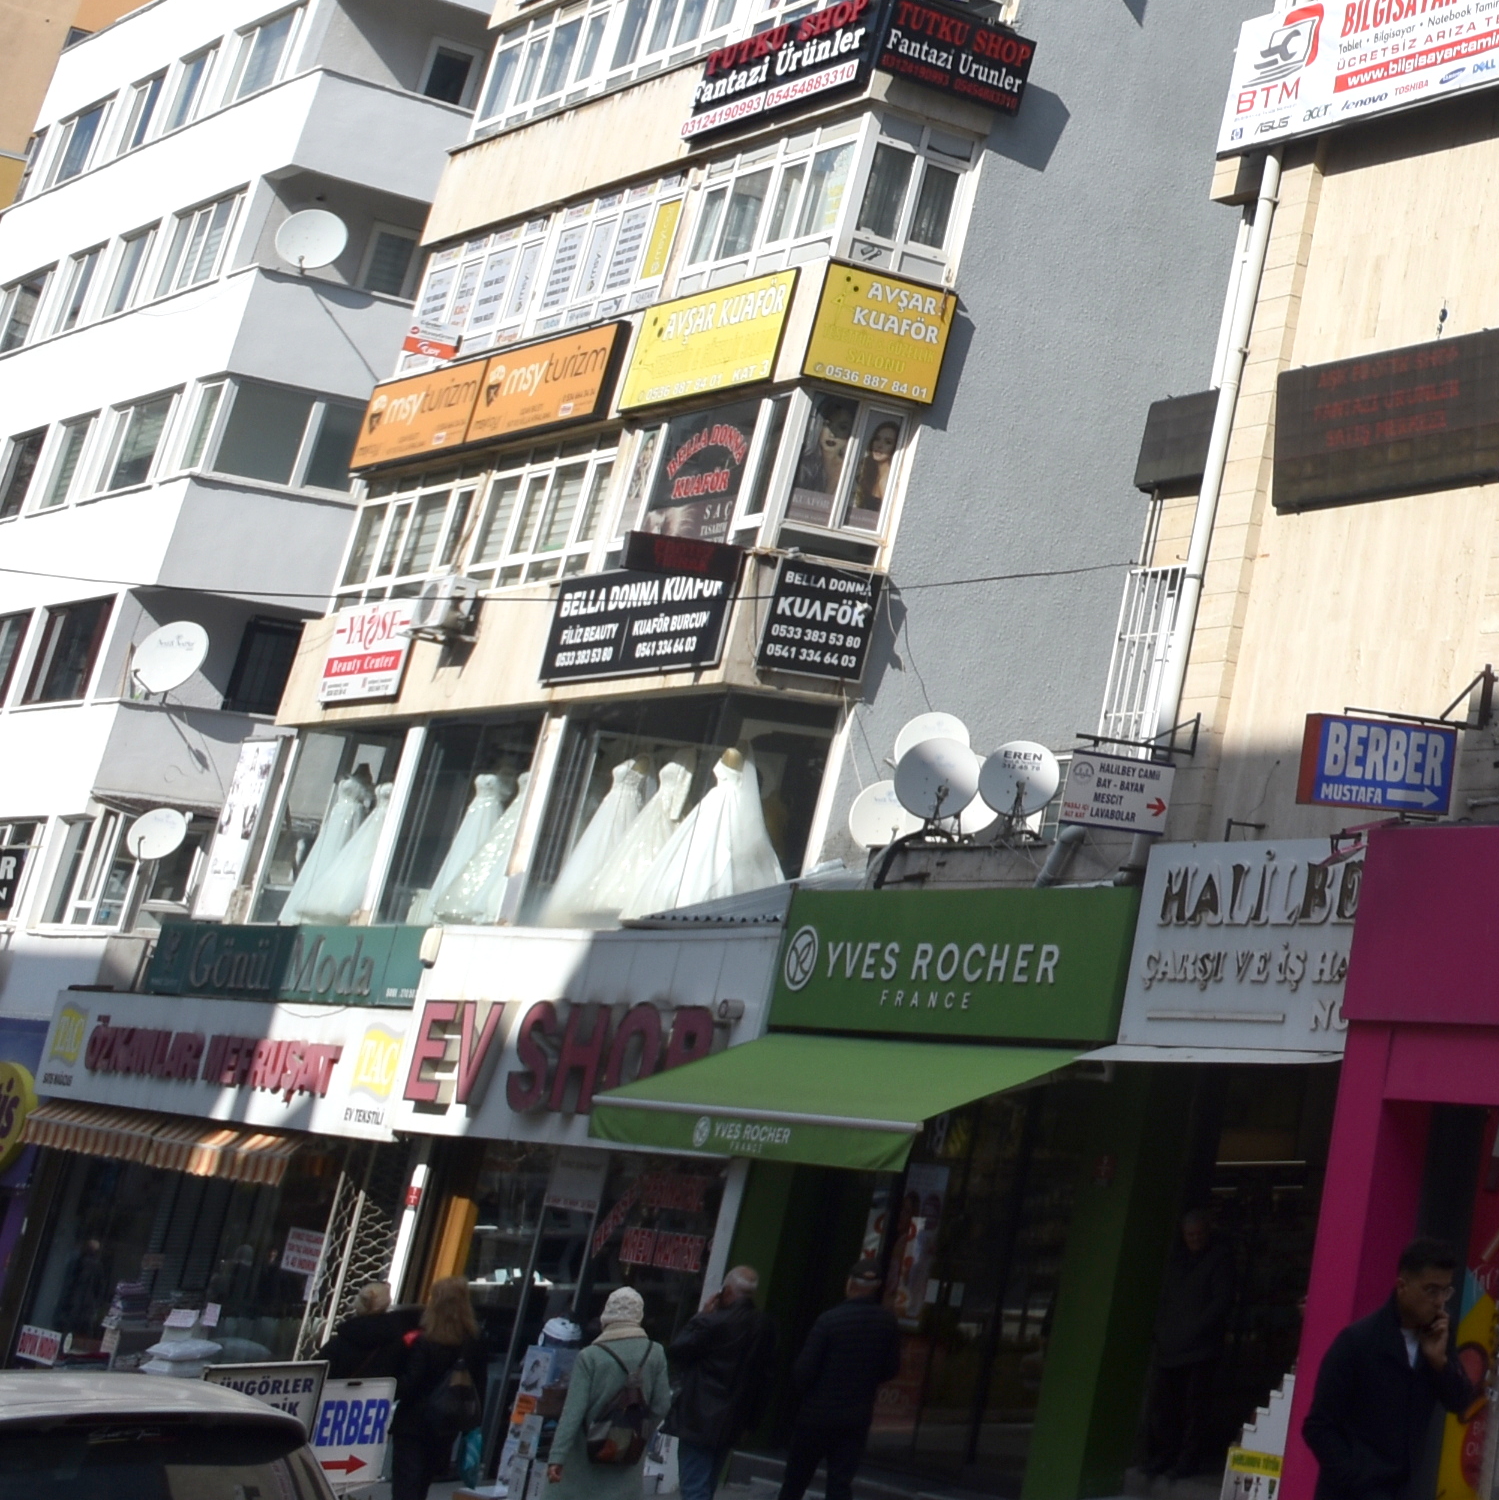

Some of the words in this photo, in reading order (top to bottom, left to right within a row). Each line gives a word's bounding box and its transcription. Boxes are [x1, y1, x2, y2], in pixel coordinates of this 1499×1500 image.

[897, 3, 972, 46] TUTKU
[975, 28, 1033, 67] SHOP
[1337, 38, 1417, 71] ÜCRETSİZ
[1424, 22, 1477, 45] ARIZA
[1339, 39, 1362, 55] Tablet
[1374, 24, 1416, 43] Bilgisayar
[1427, 5, 1472, 27] Notebook
[690, 51, 770, 108] Fantazi
[775, 25, 866, 77] Ürünler
[707, 24, 790, 77] TUTKU
[886, 28, 953, 71] Fantazi
[1236, 77, 1301, 115] BTM
[661, 307, 715, 346] AVŞAR
[717, 277, 788, 327] KUAFÖR
[867, 281, 937, 315] AVŞAR
[853, 306, 940, 345] KUAFÖR
[847, 350, 906, 374] SALONU
[709, 424, 749, 465] DONNA
[670, 467, 731, 499] KUAFÖR
[560, 591, 606, 618] BELLA
[608, 581, 660, 610] DONNA
[784, 570, 827, 590] BELLA
[829, 577, 873, 597] DONNA
[561, 625, 584, 645] FİLİZ
[584, 622, 619, 642] BEAUTY
[632, 613, 669, 637] KUAFÖR
[777, 596, 866, 629] KUAFÖR
[331, 659, 362, 674] Beauty
[364, 656, 395, 670] Center
[1004, 751, 1043, 762] EREN
[1323, 722, 1446, 787] BERBER
[1096, 777, 1112, 788] BAY
[1120, 780, 1145, 793] BAYAN
[1319, 782, 1384, 806] MUSTAFA
[1090, 806, 1136, 823] LAVABOLAR
[188, 935, 285, 990] Gönül
[284, 934, 375, 995] Moda
[825, 941, 899, 980] YVES
[910, 942, 1061, 984] ROCHER
[879, 988, 972, 1010] FRANCE
[84, 1014, 206, 1081] ÖZKANLAR
[202, 1033, 344, 1104] MEFRUŞAT
[403, 1000, 505, 1104] EV
[506, 999, 715, 1115] SHOP
[343, 1107, 355, 1121] EV
[355, 1106, 385, 1126] TEKSTİLİ
[712, 1121, 743, 1141] YVES
[744, 1124, 792, 1144] ROCHER
